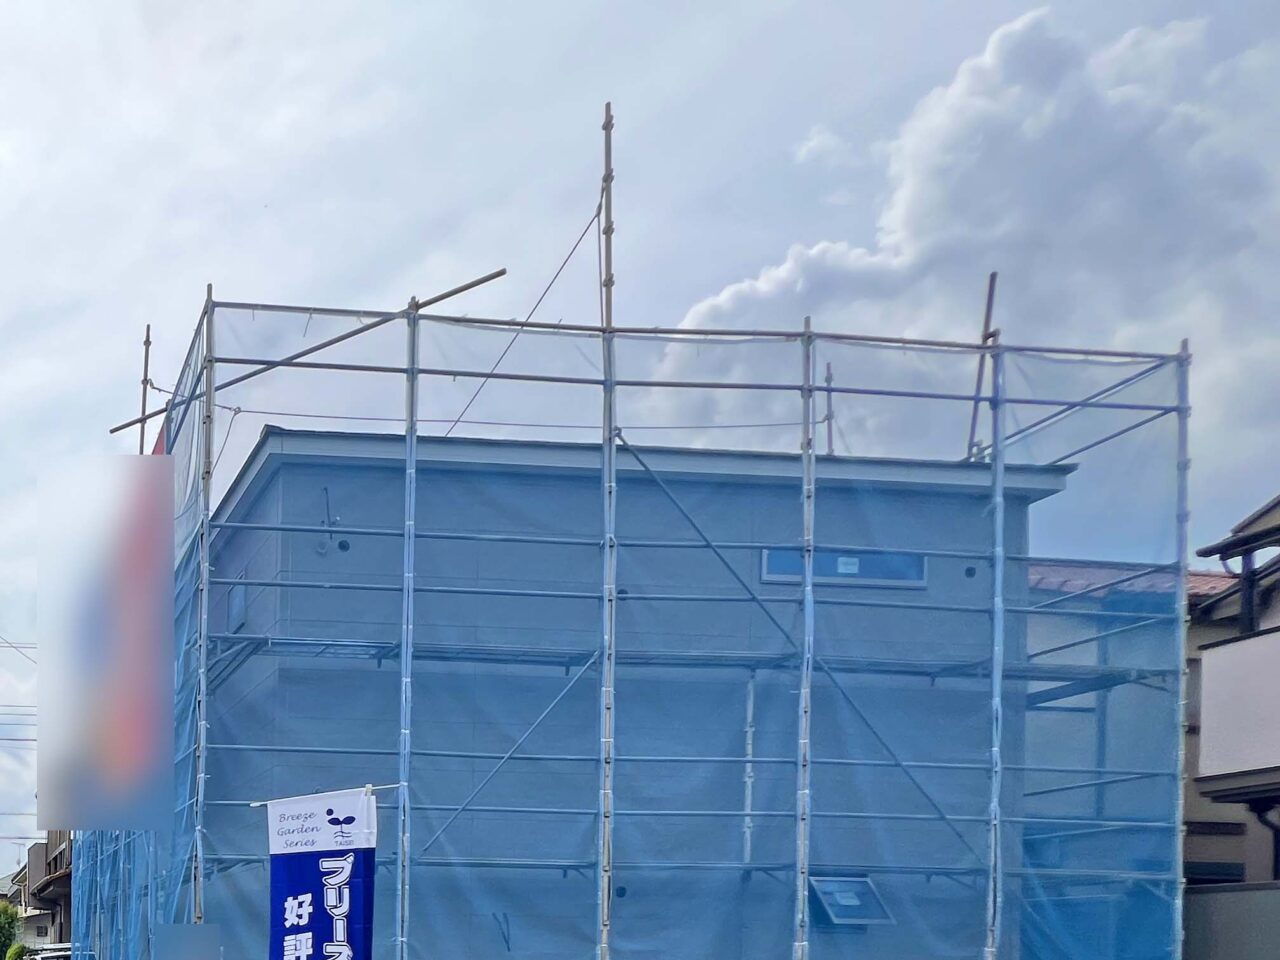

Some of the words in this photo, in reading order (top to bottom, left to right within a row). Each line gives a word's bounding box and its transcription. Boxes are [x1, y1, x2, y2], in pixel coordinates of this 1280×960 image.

[279, 811, 317, 823] Breeze
[277, 824, 321, 837] Garden
[283, 838, 317, 849] Series
